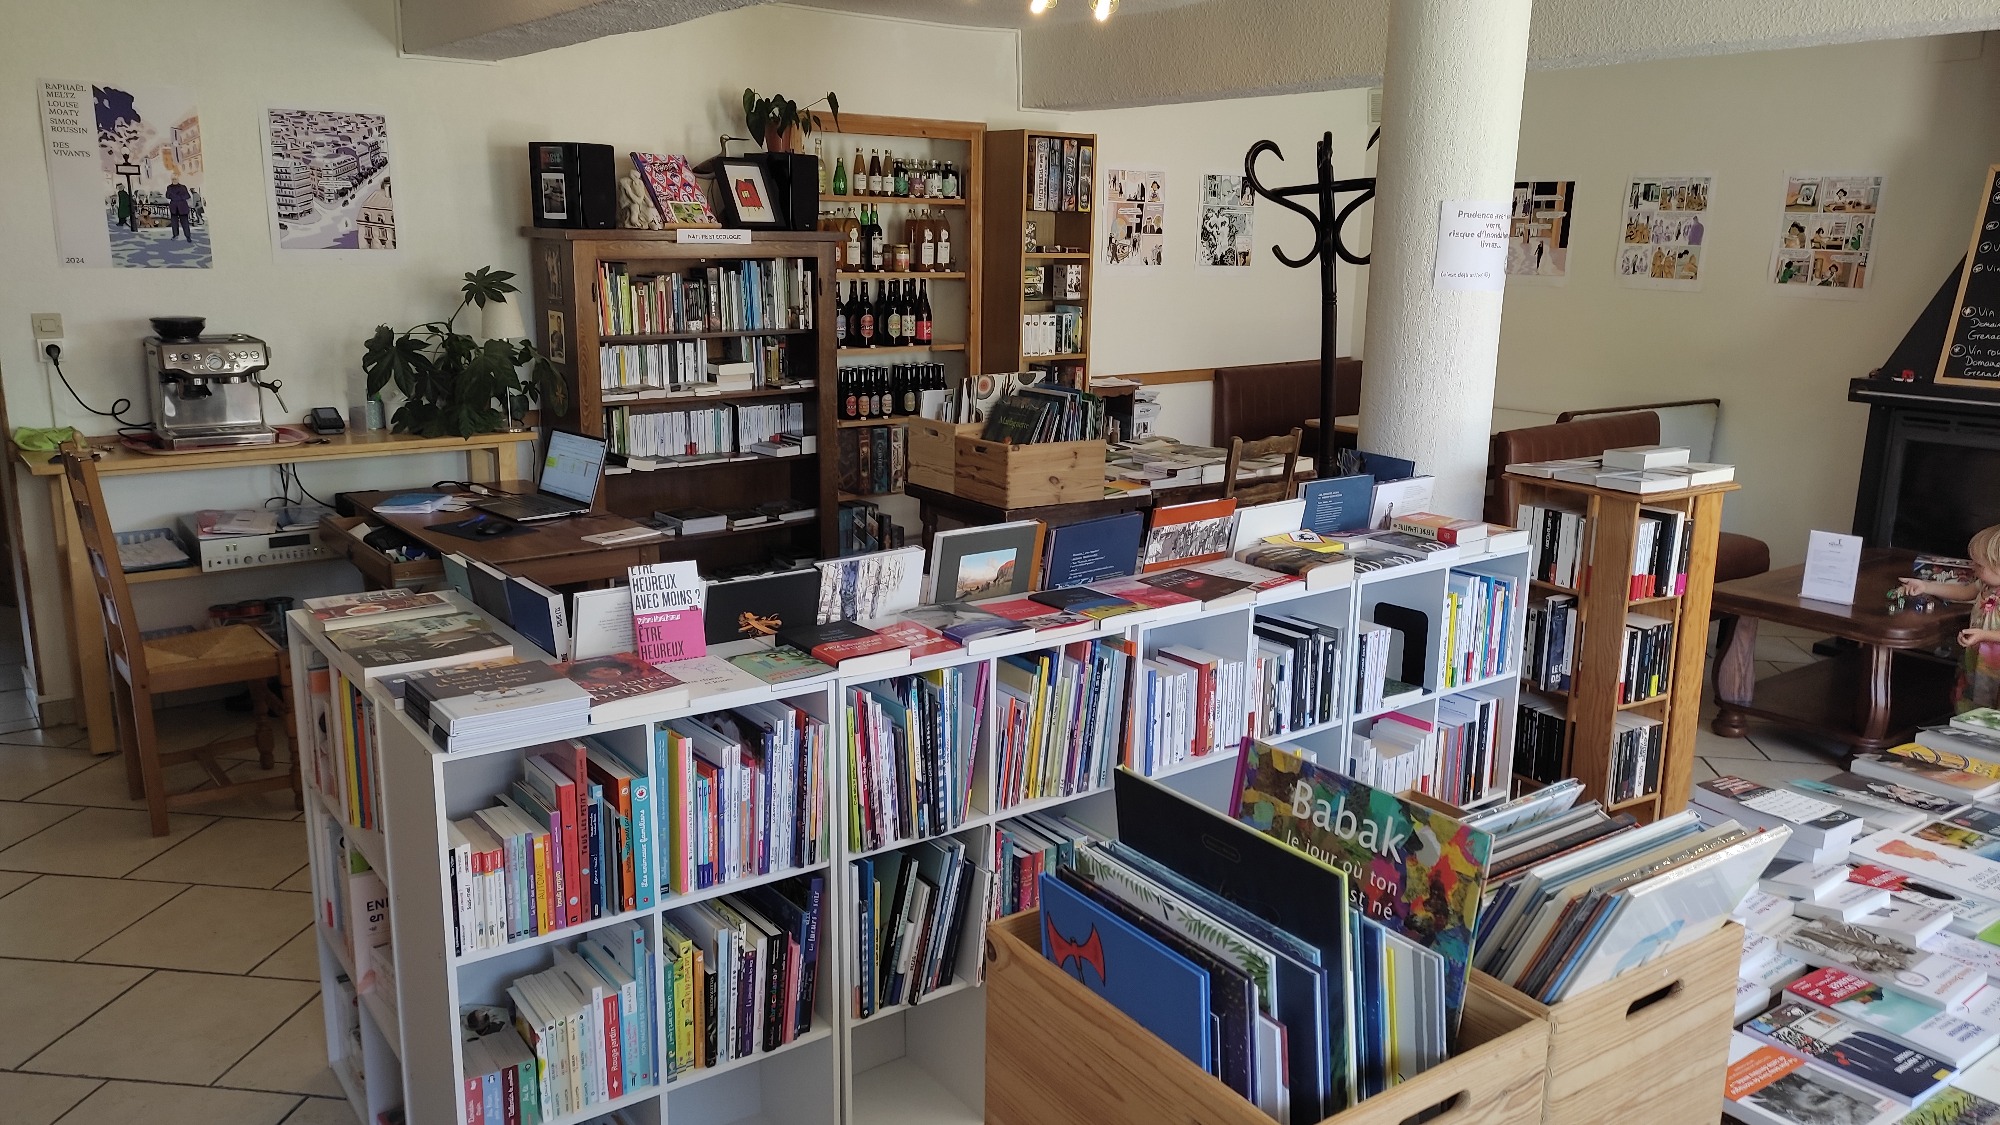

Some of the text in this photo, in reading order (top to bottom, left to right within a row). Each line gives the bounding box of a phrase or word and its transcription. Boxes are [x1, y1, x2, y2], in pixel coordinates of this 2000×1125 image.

[44, 82, 87, 92] RAPHAËL
[46, 91, 76, 99] MELTZ
[47, 100, 79, 108] LOUISE
[48, 108, 80, 117] MOATY
[50, 117, 78, 125] SIMON
[51, 125, 88, 134] ROUSSIN
[52, 141, 70, 149] DES
[53, 149, 91, 158] VIVANTS
[1448, 229, 1475, 239] risque
[65, 256, 85, 264] 2024
[1978, 306, 1995, 317] Vin
[1968, 345, 1982, 355] Vin
[632, 573, 678, 594] HEUREUX
[635, 588, 702, 611] AVEC MOINS ?
[638, 625, 664, 643] ÊTRE
[640, 641, 685, 661] HEUREUX
[638, 808, 647, 843] familiers
[1291, 779, 1407, 865] Babak
[1285, 829, 1398, 897] le jour où ton
[536, 861, 544, 900] AUTOMNE
[1350, 888, 1394, 921] st né
[369, 913, 384, 923] en
[608, 1025, 619, 1072] Rouge jardin
